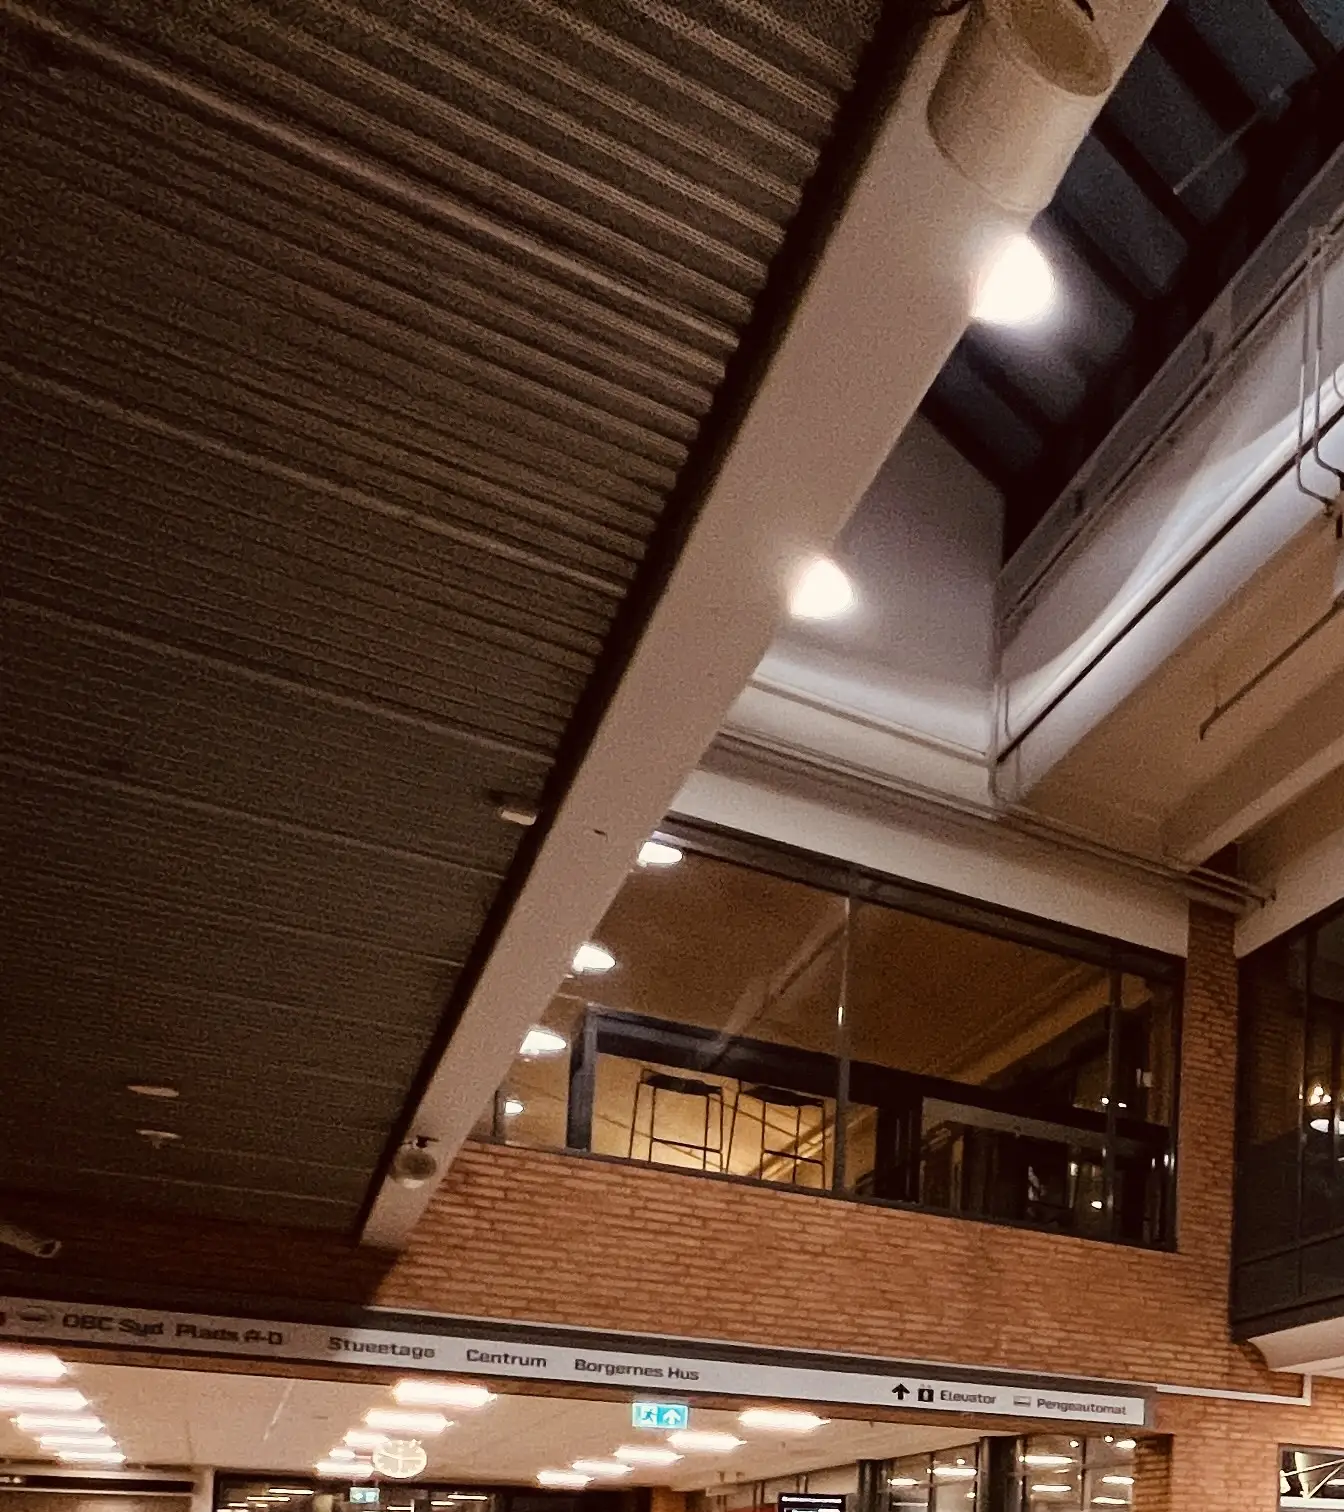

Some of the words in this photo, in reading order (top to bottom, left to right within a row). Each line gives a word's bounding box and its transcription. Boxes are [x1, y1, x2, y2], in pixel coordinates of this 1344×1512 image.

[327, 1336, 436, 1360] Stueetage
[466, 1348, 548, 1369] Centrum
[574, 1358, 664, 1379] Borgernes
[667, 1367, 700, 1382] Hus
[940, 1389, 997, 1406] Elevator
[1036, 1397, 1128, 1417] Pengeautomat
